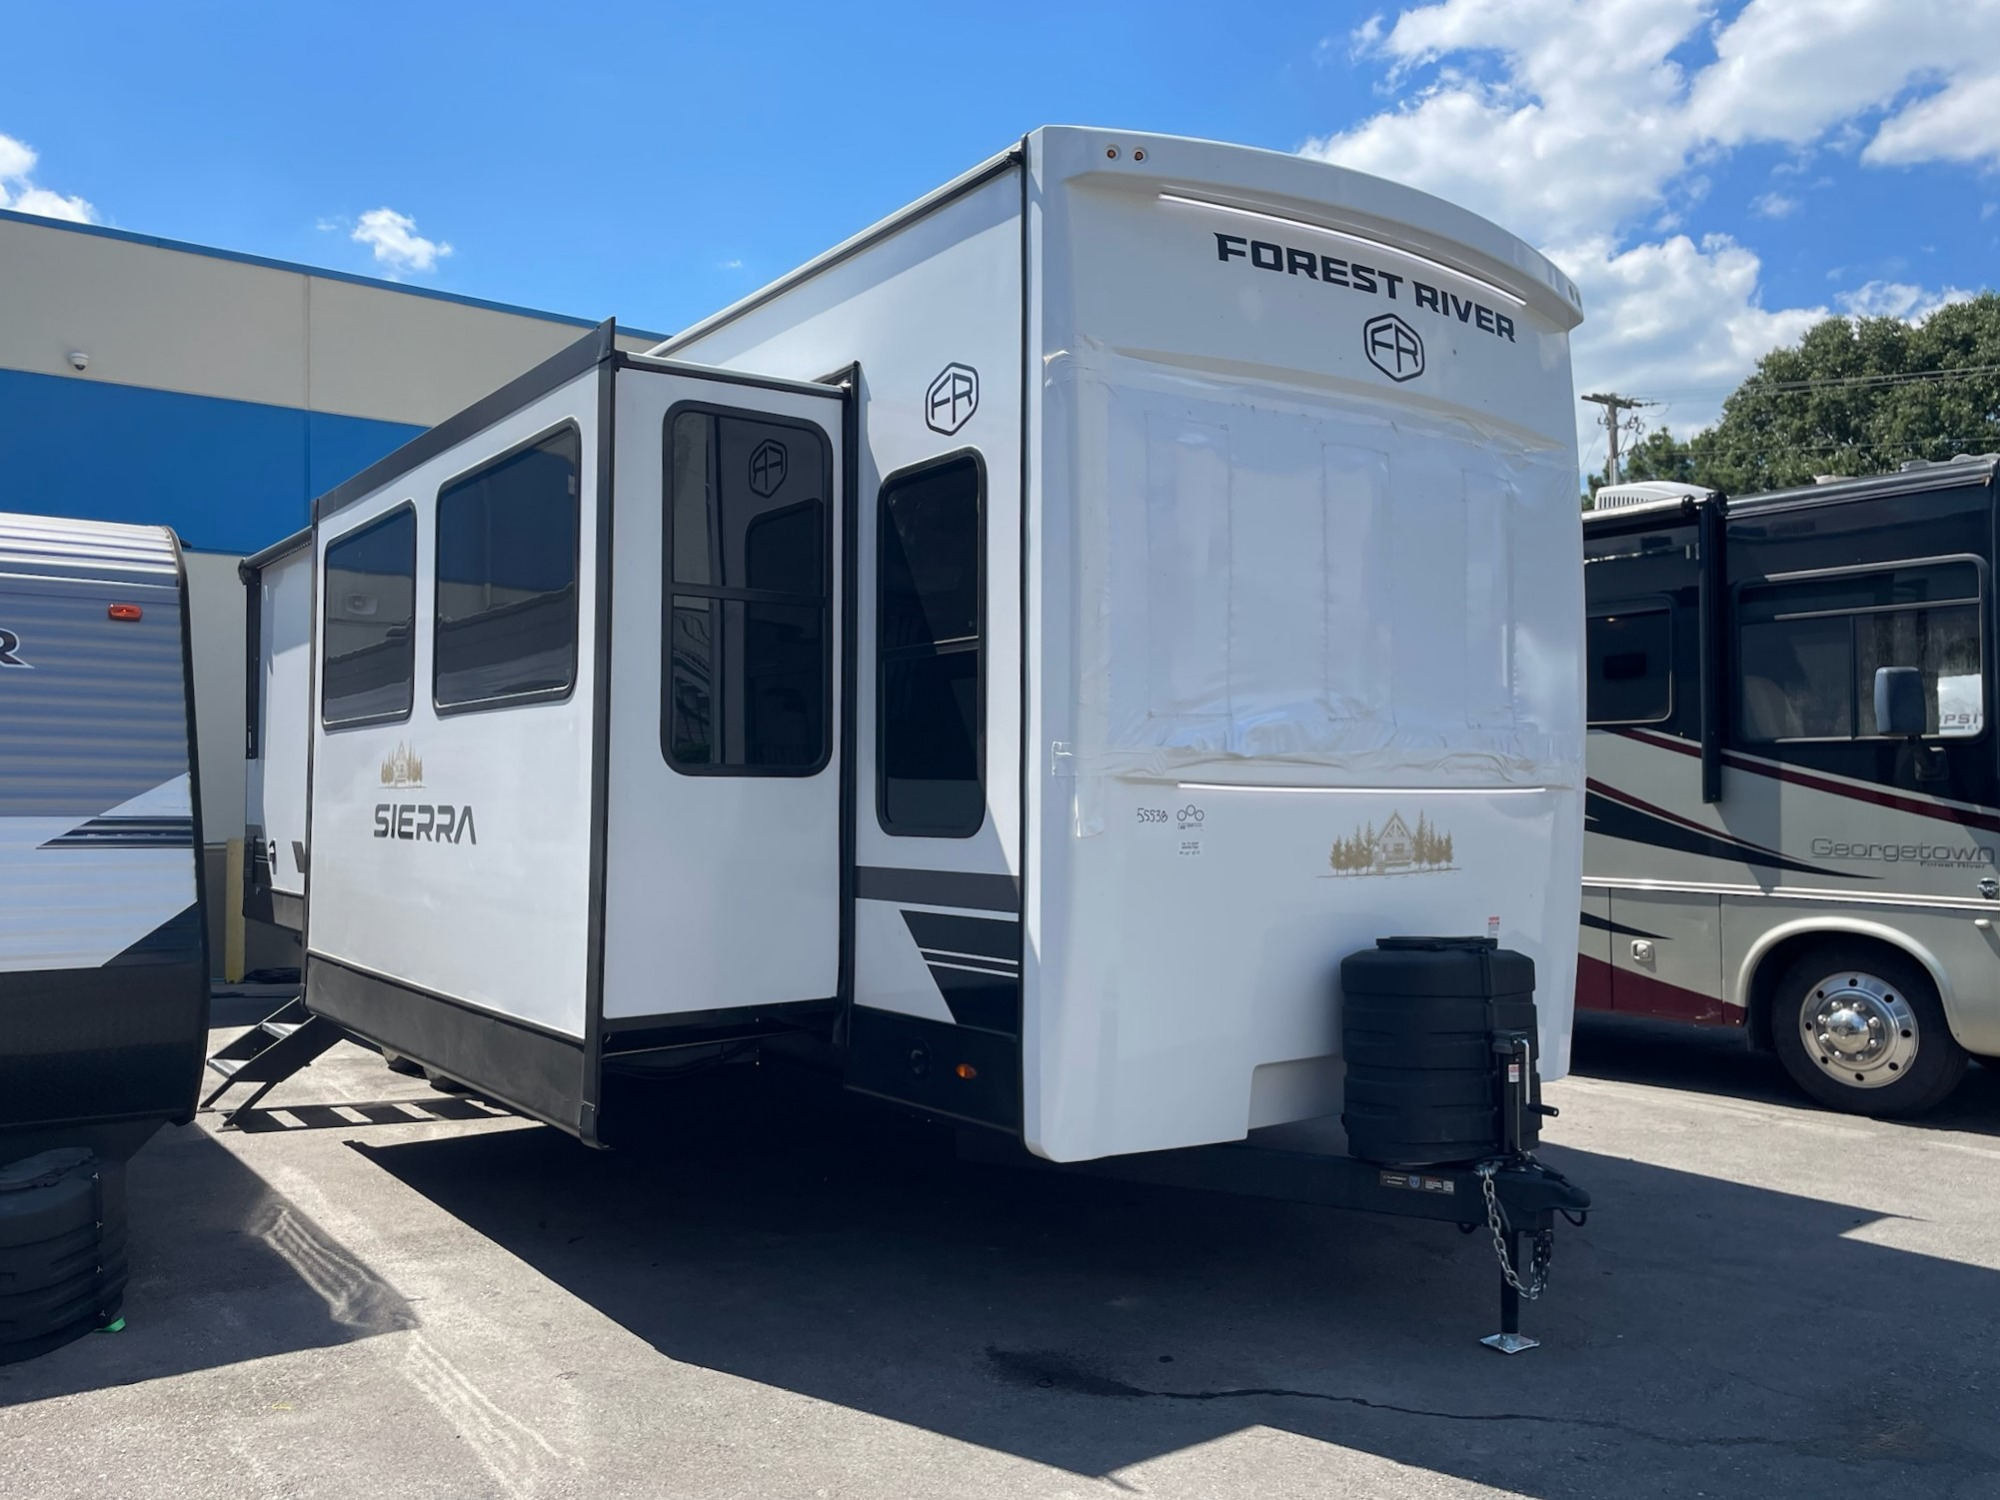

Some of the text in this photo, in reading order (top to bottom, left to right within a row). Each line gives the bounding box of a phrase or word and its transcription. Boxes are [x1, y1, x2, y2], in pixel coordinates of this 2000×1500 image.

[1213, 232, 1516, 343] FOREST RIVER
[374, 803, 477, 845] SIERRA
[1811, 837, 1996, 865] Georgetown
